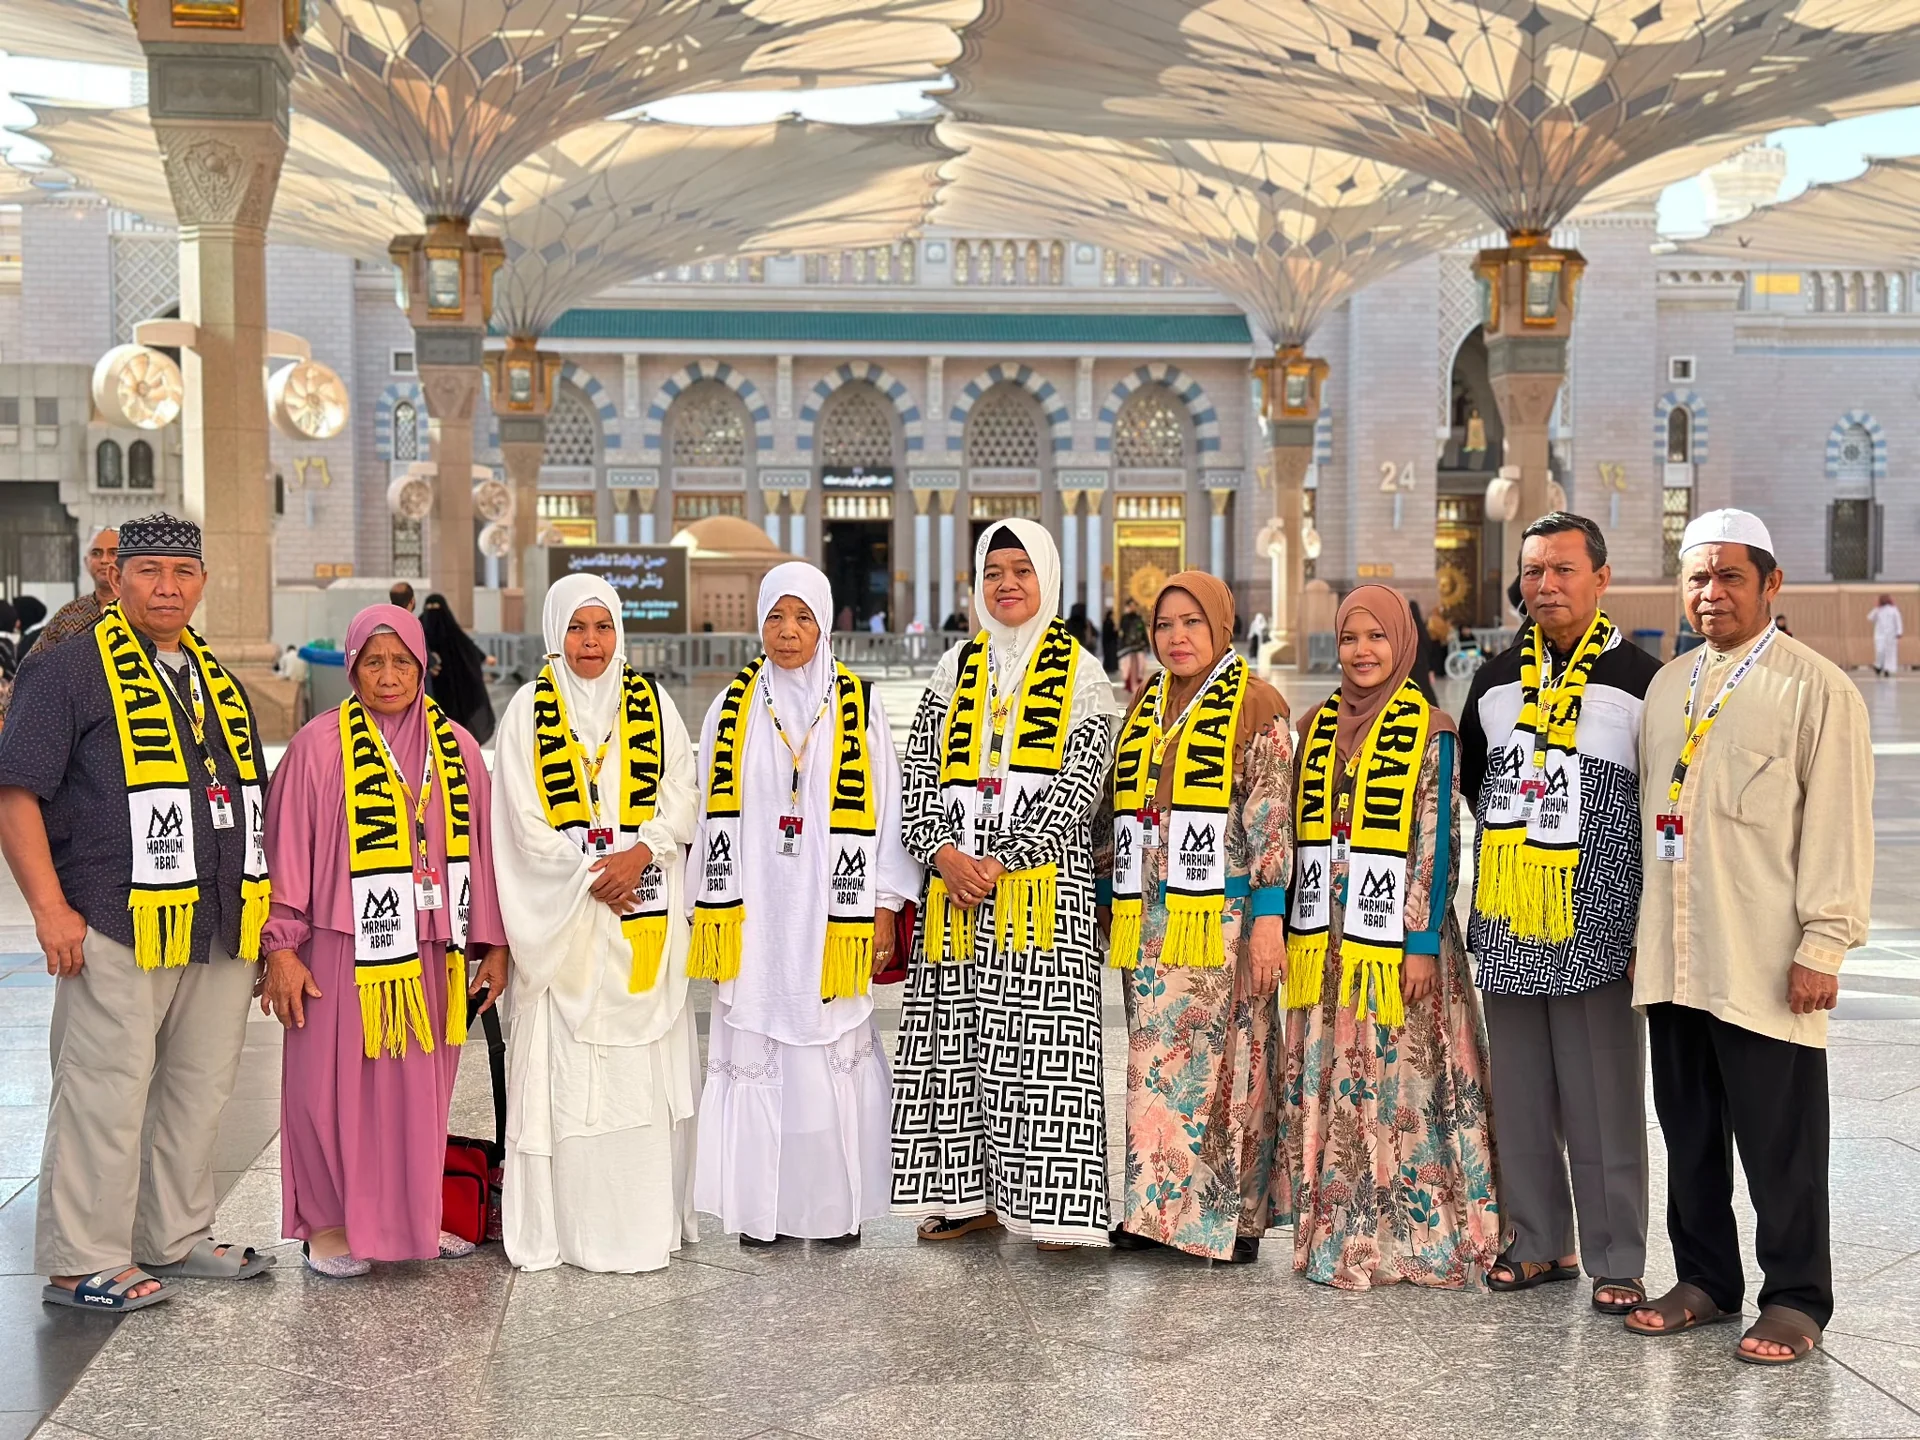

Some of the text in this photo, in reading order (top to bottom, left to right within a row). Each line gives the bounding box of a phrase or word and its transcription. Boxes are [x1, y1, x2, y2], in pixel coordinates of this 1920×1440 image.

[1380, 460, 1415, 491] 24
[1361, 700, 1421, 832] ABADI
[1491, 795, 1512, 811] BADI
[1179, 852, 1216, 867] MARHUMI
[1186, 867, 1210, 881] ABADI
[361, 918, 401, 934] MARHUMI
[1363, 913, 1387, 928] ABADI
[84, 1295, 113, 1305] porto
